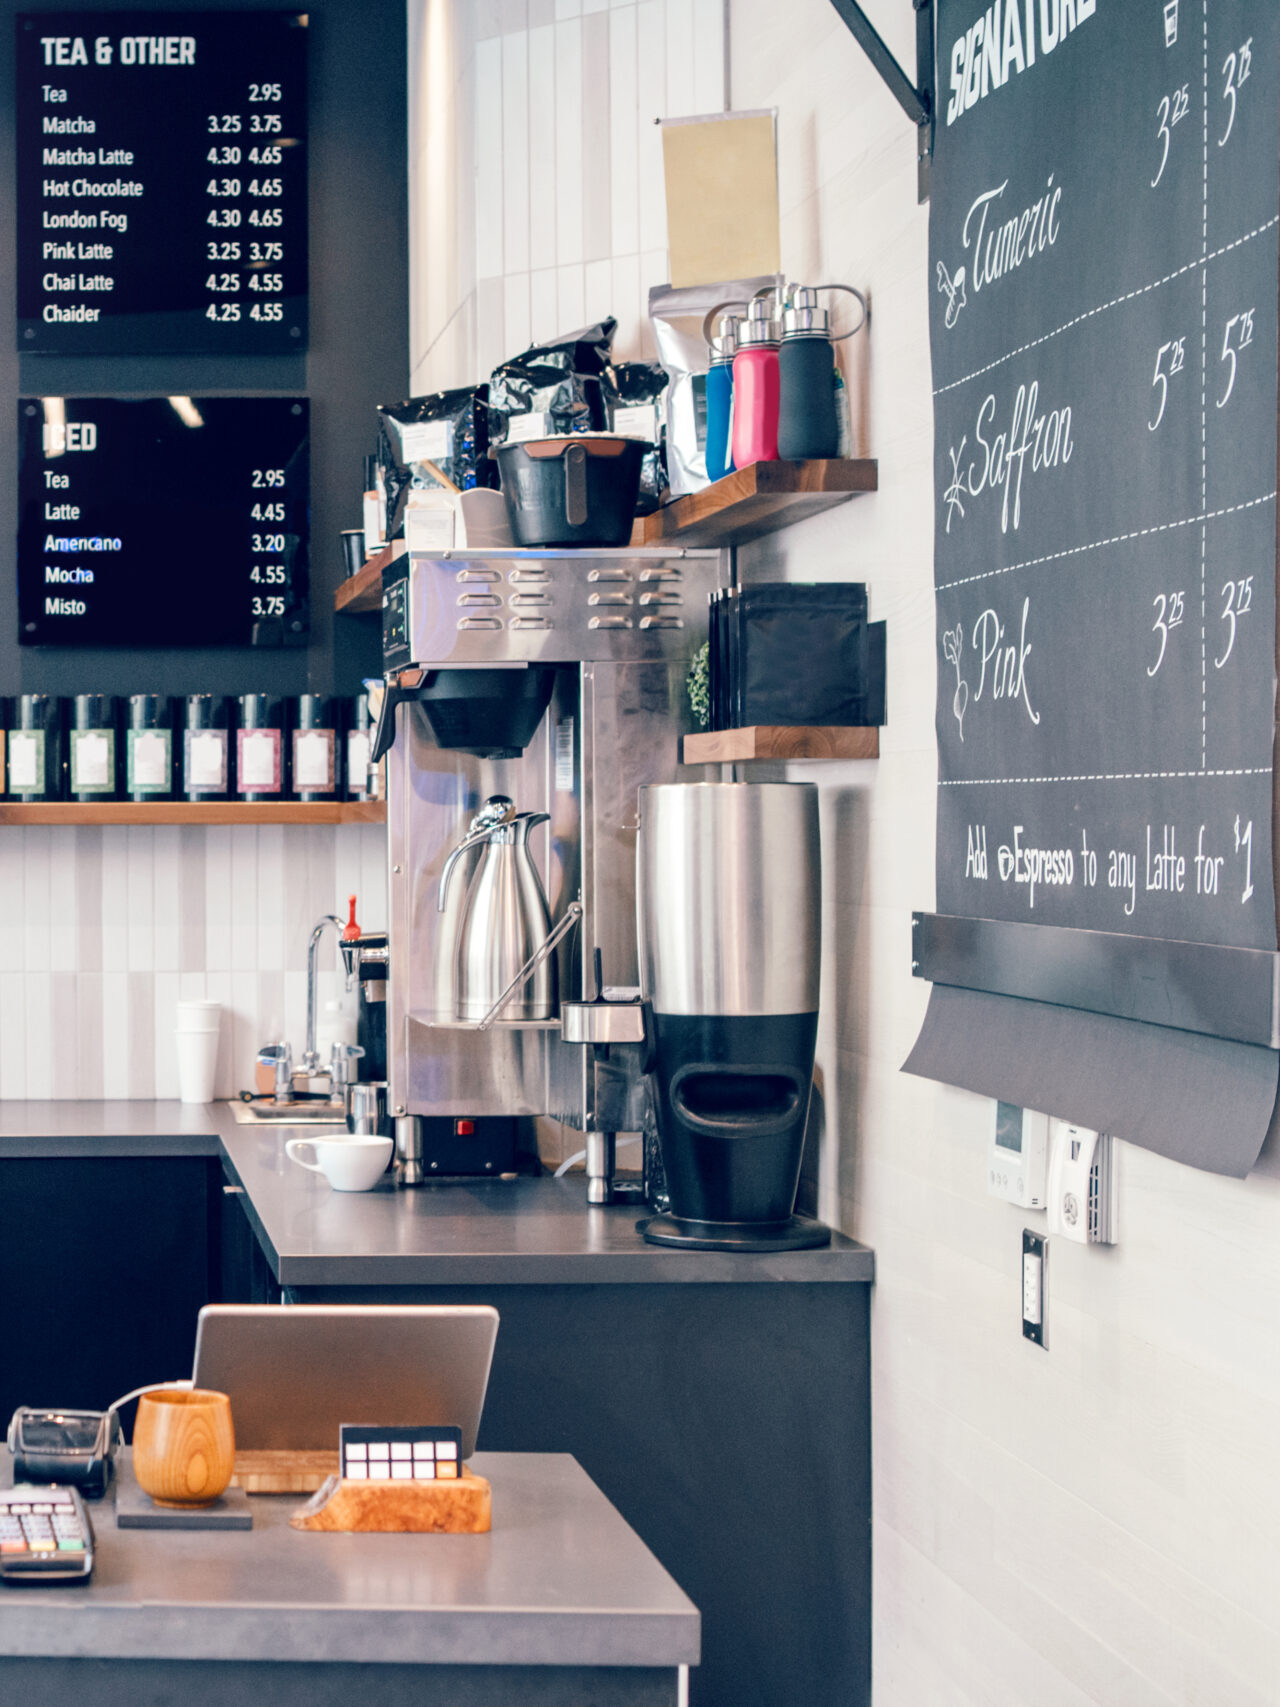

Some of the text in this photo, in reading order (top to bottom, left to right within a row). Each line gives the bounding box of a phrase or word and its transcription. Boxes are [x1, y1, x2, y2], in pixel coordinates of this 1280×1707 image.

[41, 36, 196, 66] TEA & OTHER
[947, 0, 1097, 127] SIGNATU
[42, 84, 282, 102] Tea 2.95
[43, 115, 282, 134] Matcha 3.25 3.75
[43, 147, 282, 165] Matcha Latte 4.30 4.65
[43, 179, 282, 196] Hot Chocolate 4.30 4.65
[43, 210, 282, 232] London Fog 4.30 4.65
[962, 172, 1062, 293] Tumeric
[43, 242, 283, 260] Pink Latte 3.25 3.75
[43, 274, 283, 292] Chai Latte 4.25 4.55
[43, 304, 283, 322] Chaider 4.25 4.55
[42, 423, 97, 451] ICED
[968, 380, 1073, 534] Saffron
[44, 470, 285, 488] Tea 2.95
[45, 503, 285, 521] Latte 4.45
[44, 534, 285, 552] Americano 3.20
[45, 566, 285, 584] Mocha 4.55
[45, 597, 285, 615] Misto 3.75
[972, 596, 1040, 725] Pink
[965, 825, 988, 880] Add
[1014, 826, 1073, 908] Espresso
[1081, 829, 1097, 887] to
[1108, 848, 1136, 915] any
[1145, 825, 1185, 892] Latte
[1194, 825, 1224, 895] for
